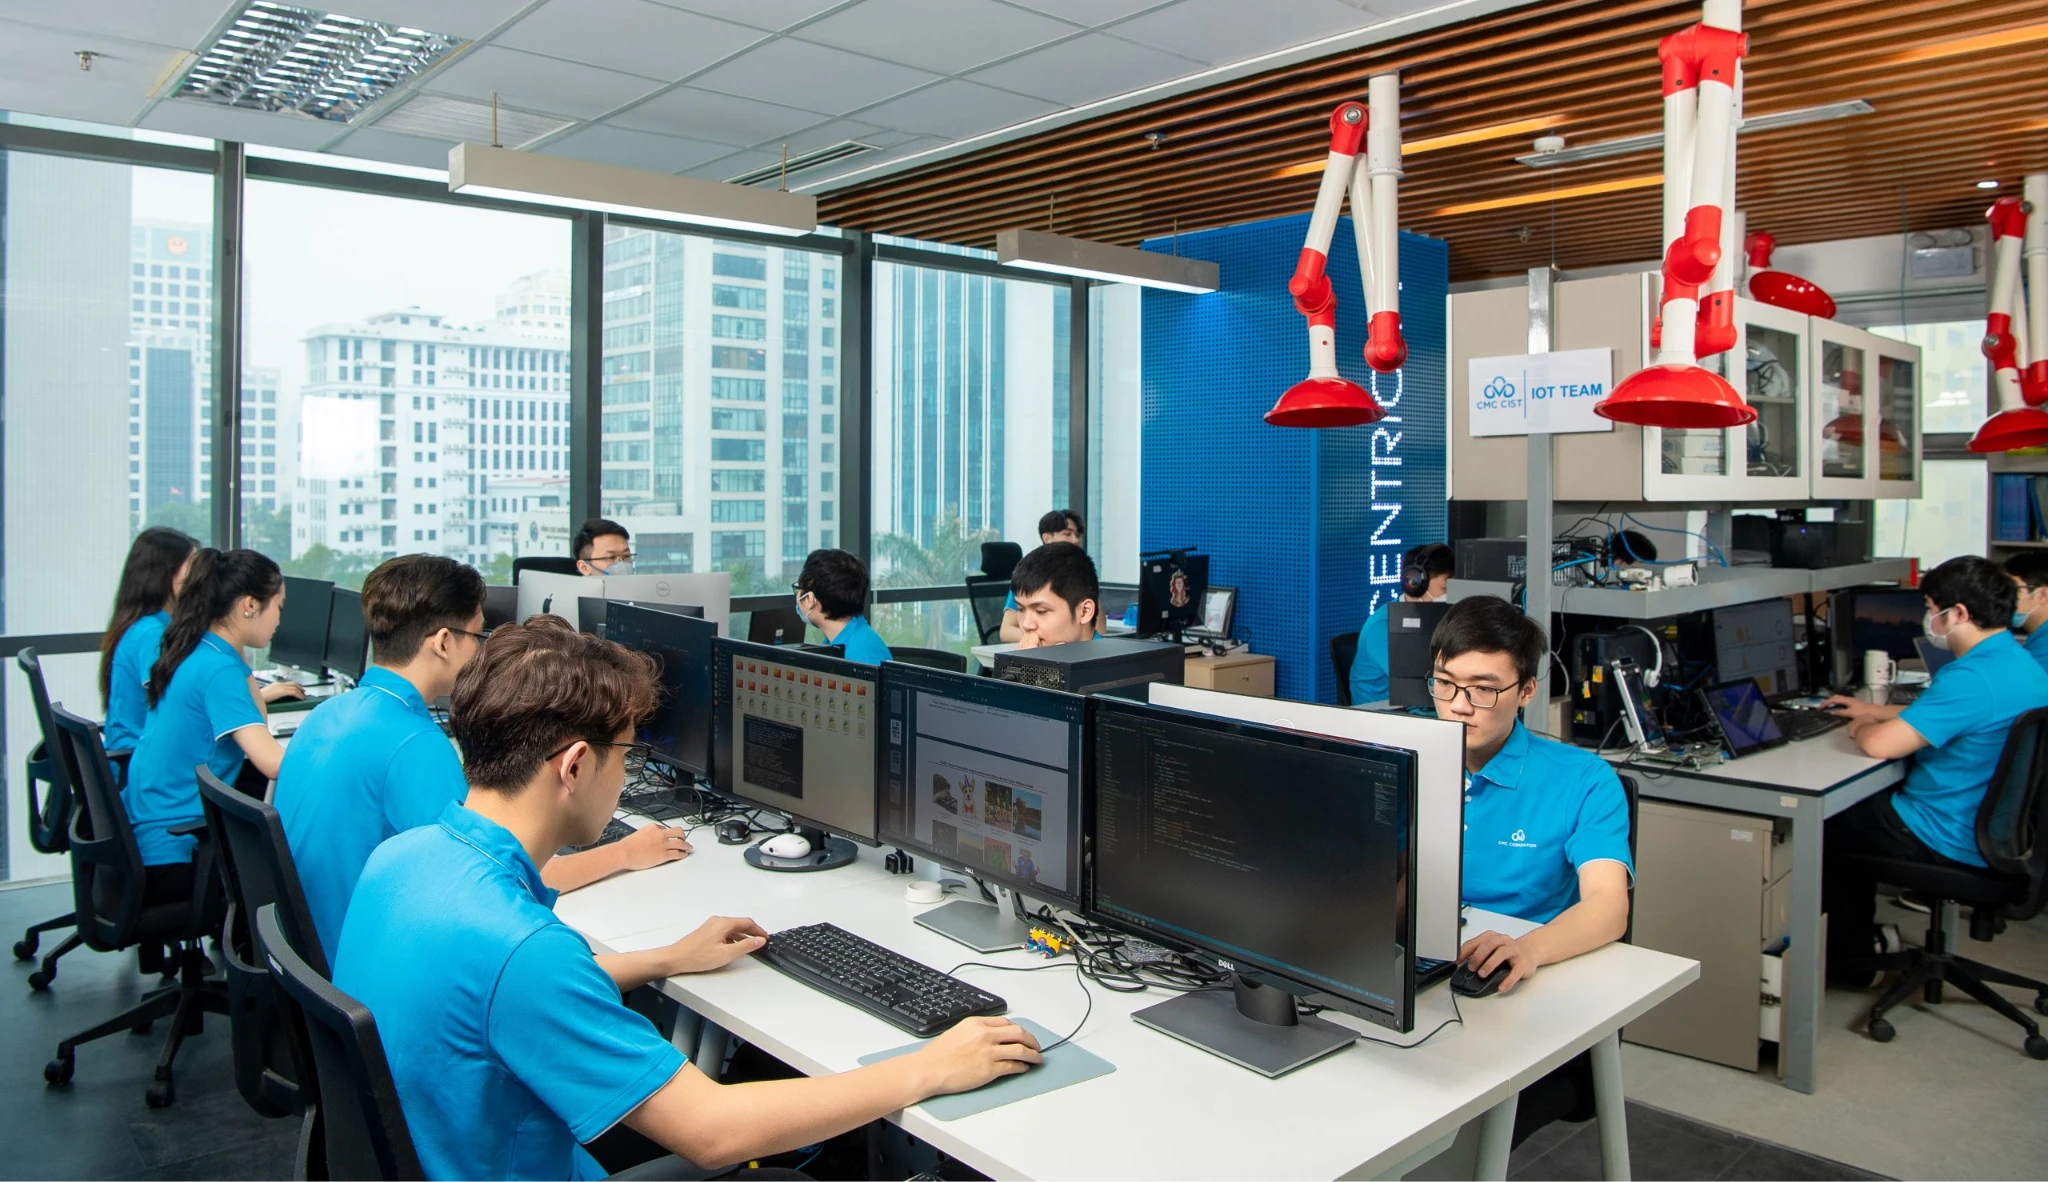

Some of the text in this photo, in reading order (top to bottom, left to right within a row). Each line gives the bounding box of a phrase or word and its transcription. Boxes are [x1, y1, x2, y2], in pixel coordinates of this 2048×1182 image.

[1531, 383, 1602, 399] IOT TEAM
[1476, 399, 1522, 409] CMC CIST
[1218, 959, 1234, 970] DELL
